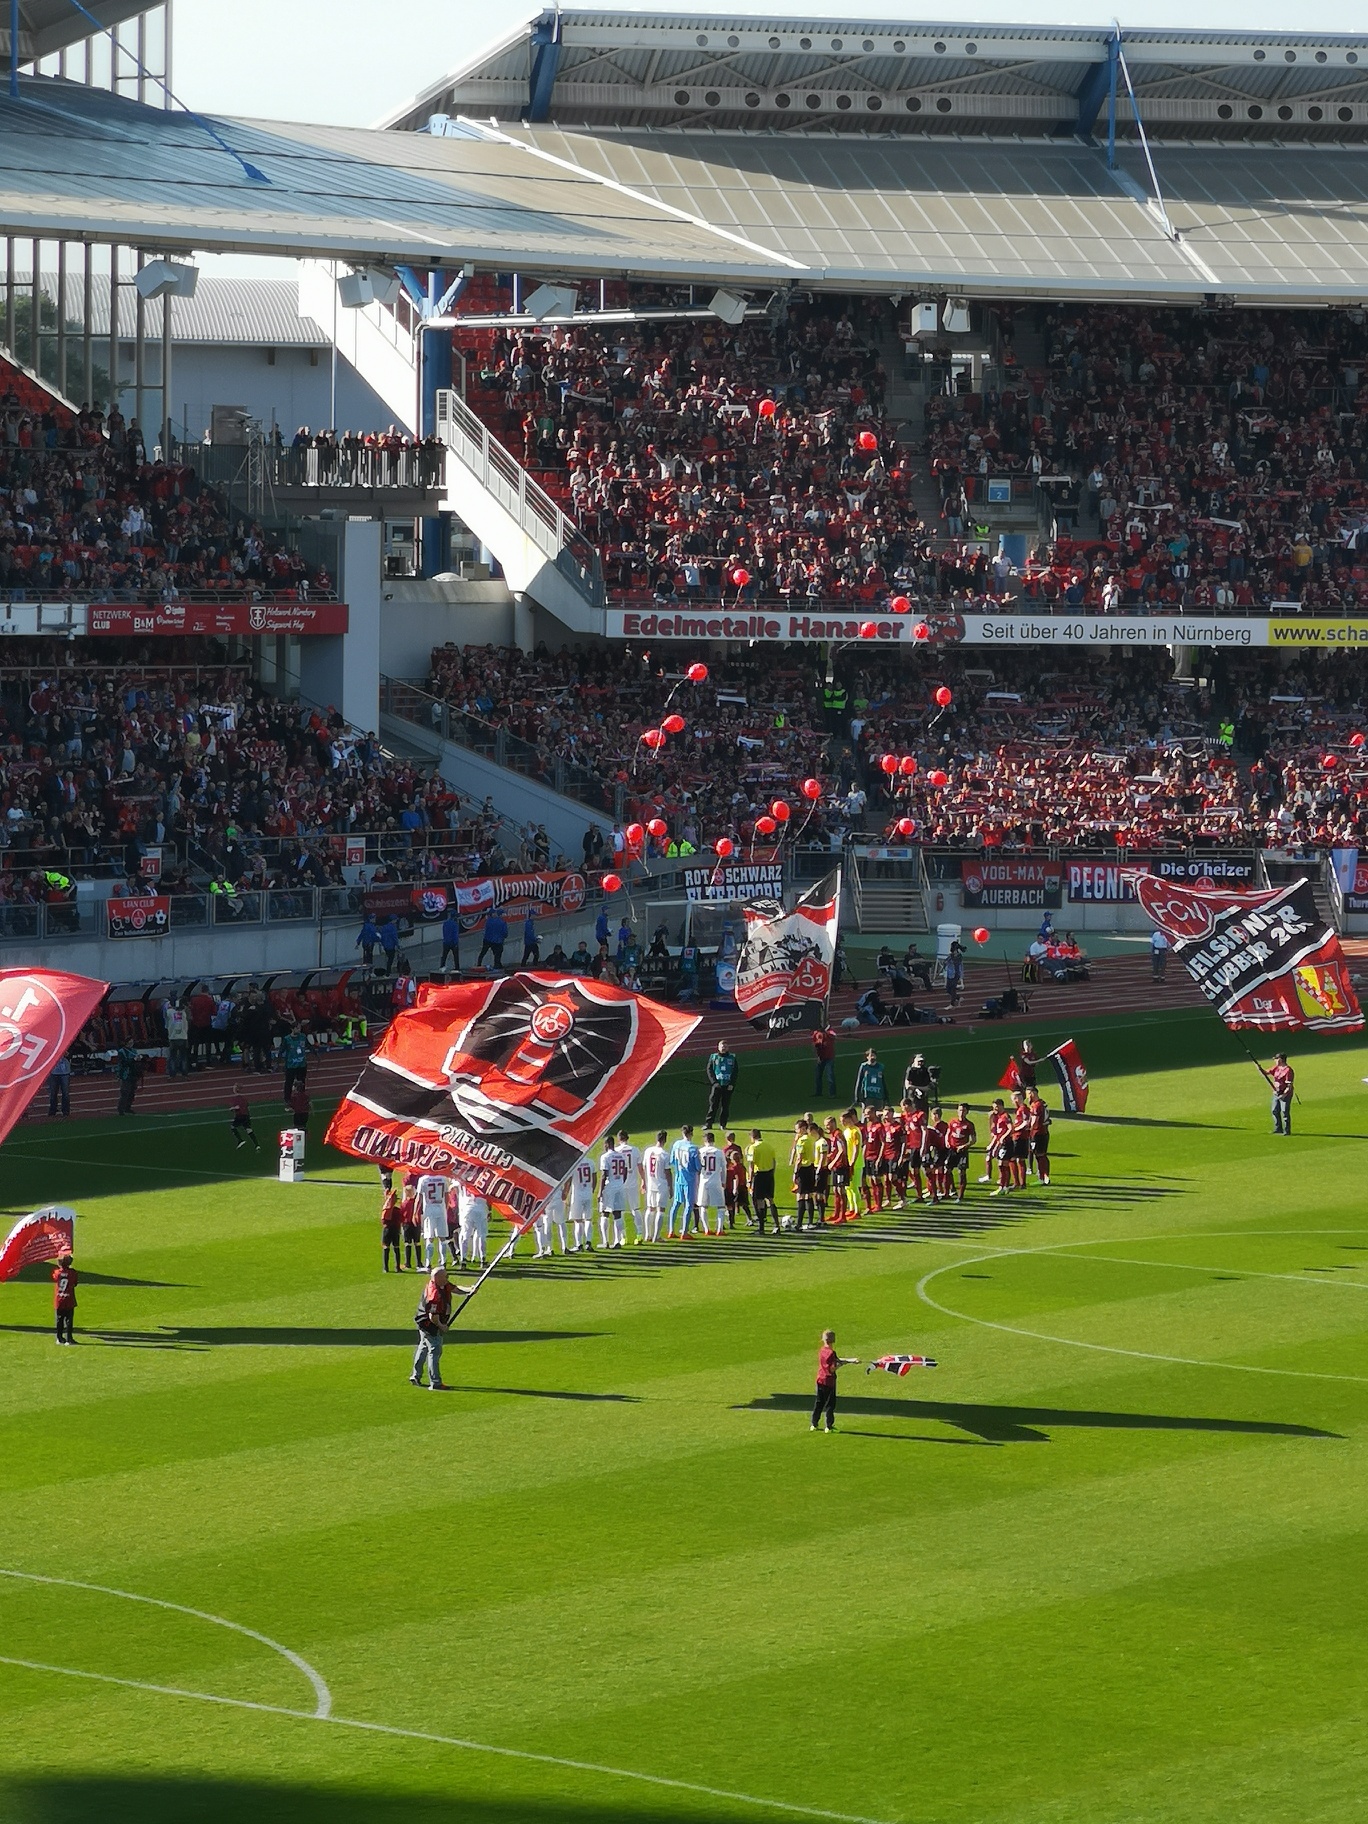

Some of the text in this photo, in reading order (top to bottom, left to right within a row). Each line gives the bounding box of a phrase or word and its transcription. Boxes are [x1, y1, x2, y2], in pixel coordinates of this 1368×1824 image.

[93, 611, 132, 619] NETZWERK
[93, 621, 110, 630] CLUB
[134, 617, 154, 628] B&M
[623, 614, 905, 639] Edelmetalle Hanaer
[982, 623, 1251, 644] Seit über 40 Jahren in Nürnberg
[146, 864, 155, 874] 41
[684, 865, 782, 887] ROT SCHWARZ
[981, 866, 1045, 880] VOGL-MAX
[1160, 863, 1186, 877] Die
[981, 890, 1044, 904] AUERBACH
[1151, 900, 1205, 922] FCN
[577, 1166, 591, 1184] 19
[428, 1182, 445, 1199] 27
[59, 1278, 69, 1292] 9
